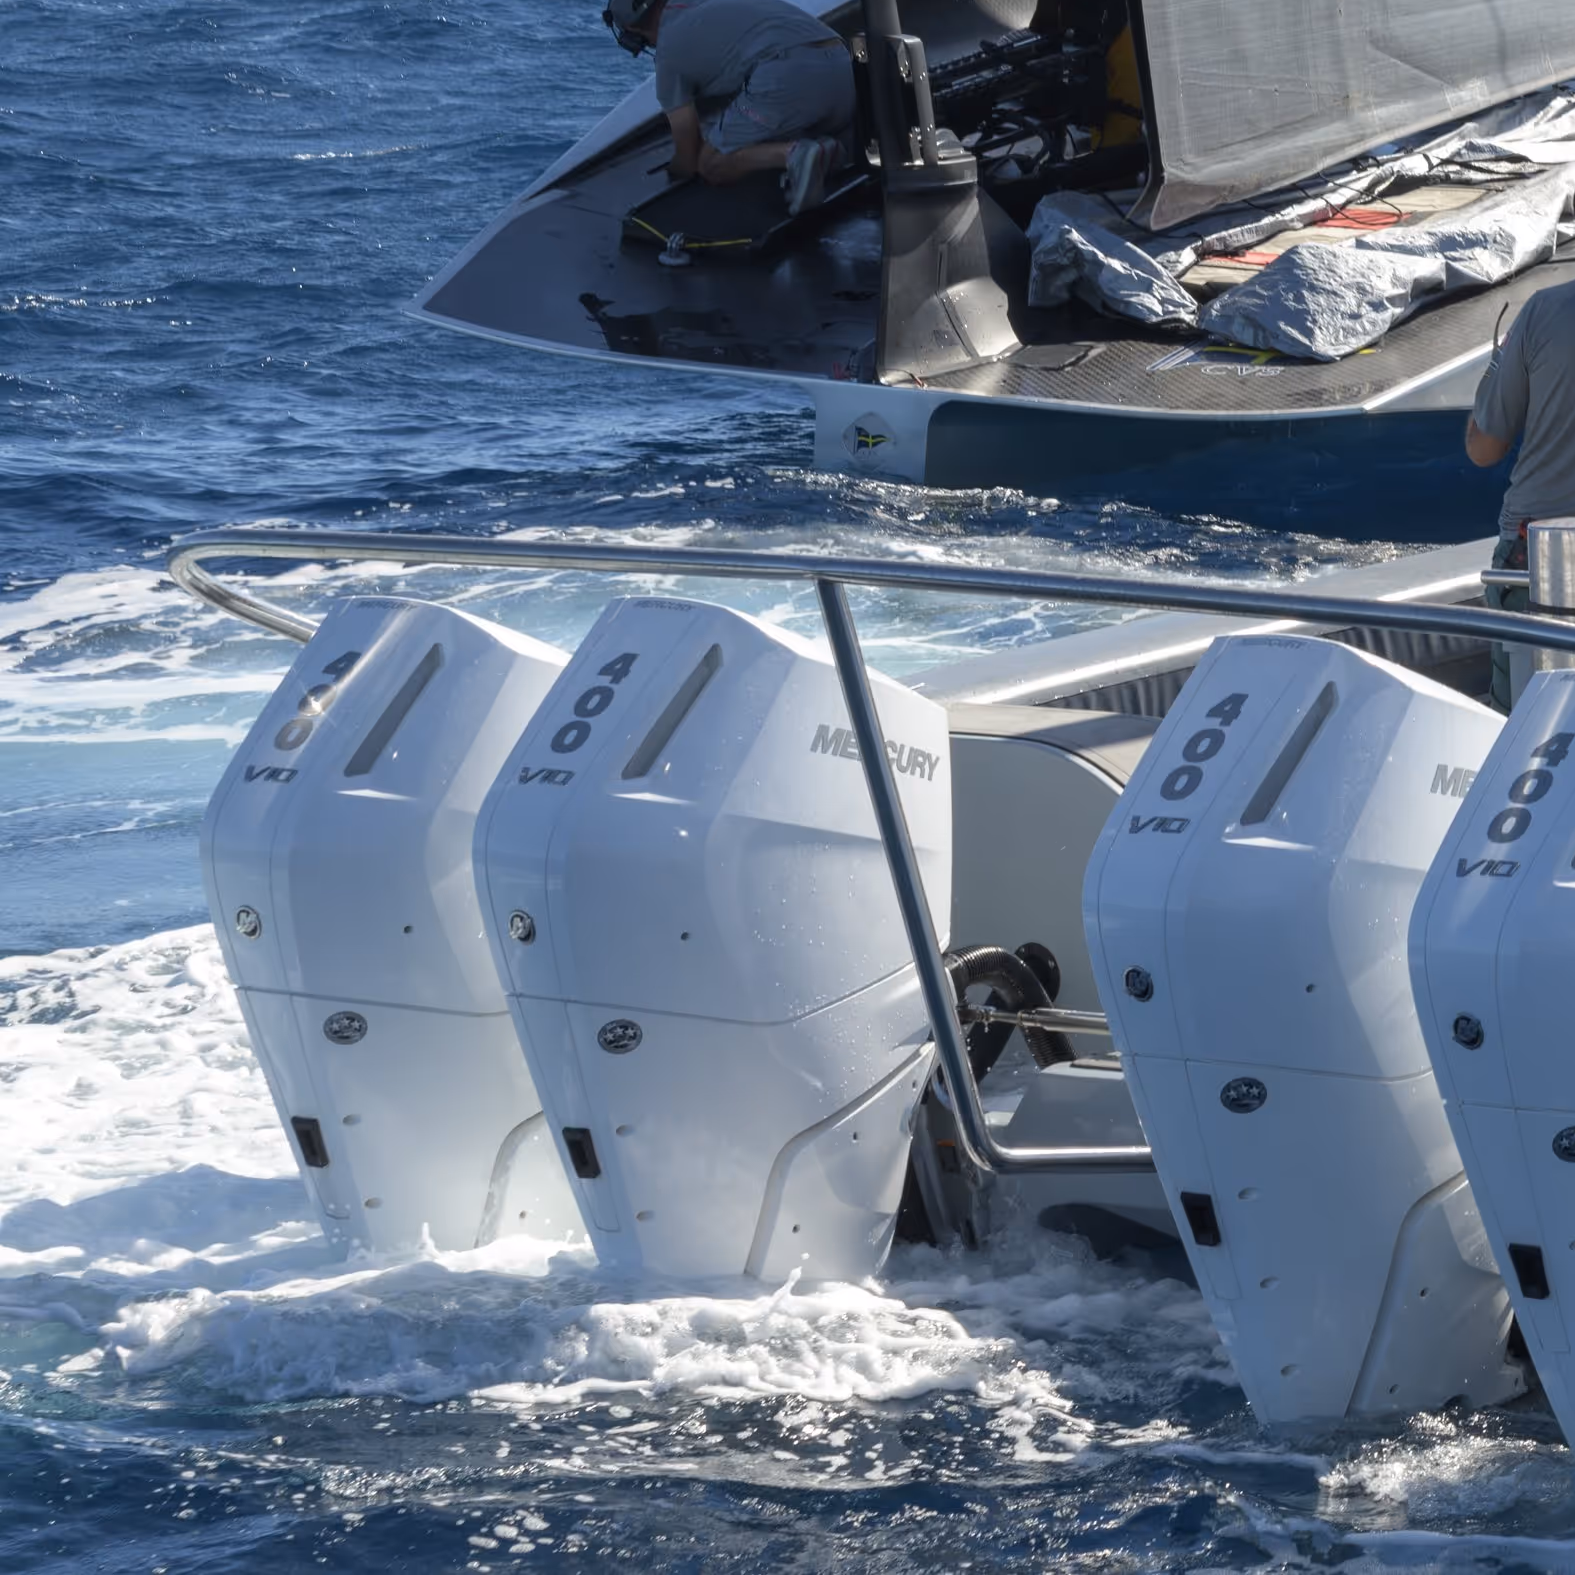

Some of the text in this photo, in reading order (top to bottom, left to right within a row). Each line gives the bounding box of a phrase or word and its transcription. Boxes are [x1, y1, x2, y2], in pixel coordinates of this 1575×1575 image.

[551, 652, 640, 754] 400
[810, 723, 940, 782] MECURY
[1160, 692, 1249, 801] 400
[1129, 815, 1191, 834] V10
[1487, 732, 1575, 844] 400
[1456, 858, 1521, 877] V10
